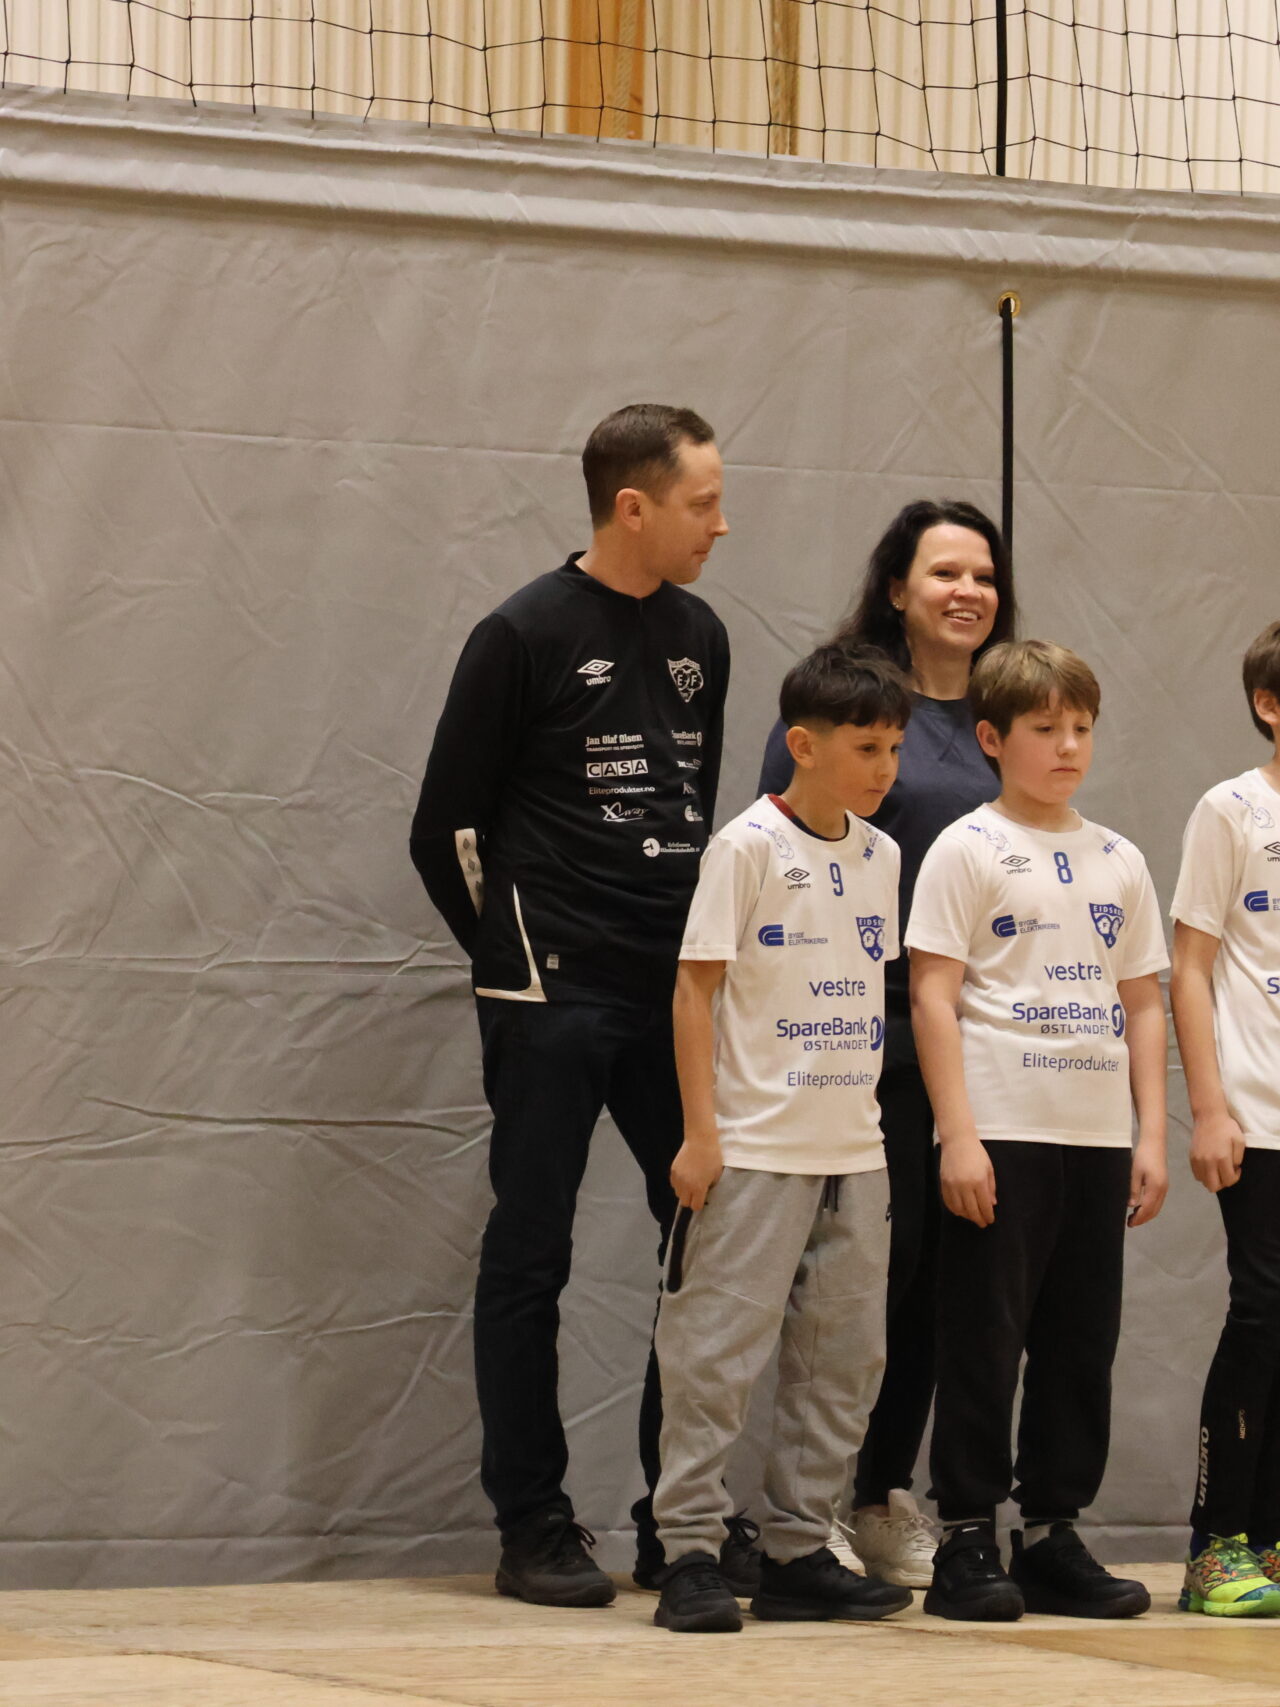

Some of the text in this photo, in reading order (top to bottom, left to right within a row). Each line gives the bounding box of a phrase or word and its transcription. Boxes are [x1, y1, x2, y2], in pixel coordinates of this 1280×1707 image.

[586, 675, 612, 686] umbro
[585, 733, 643, 747] Jan Olaf Olsen
[588, 760, 647, 777] CASA
[1006, 867, 1032, 875] umbro
[1053, 851, 1074, 884] 8
[829, 862, 844, 896] 9
[1044, 962, 1102, 981] vestre
[809, 977, 866, 997] vestre
[1012, 1002, 1109, 1023] SpareBank
[776, 1017, 868, 1040] SpareBank
[1040, 1024, 1110, 1035] ØSTLANDET
[803, 1040, 868, 1051] ØSTLANDET
[1023, 1053, 1119, 1072] Eliteprodukter
[787, 1070, 874, 1089] Eliteprodukte
